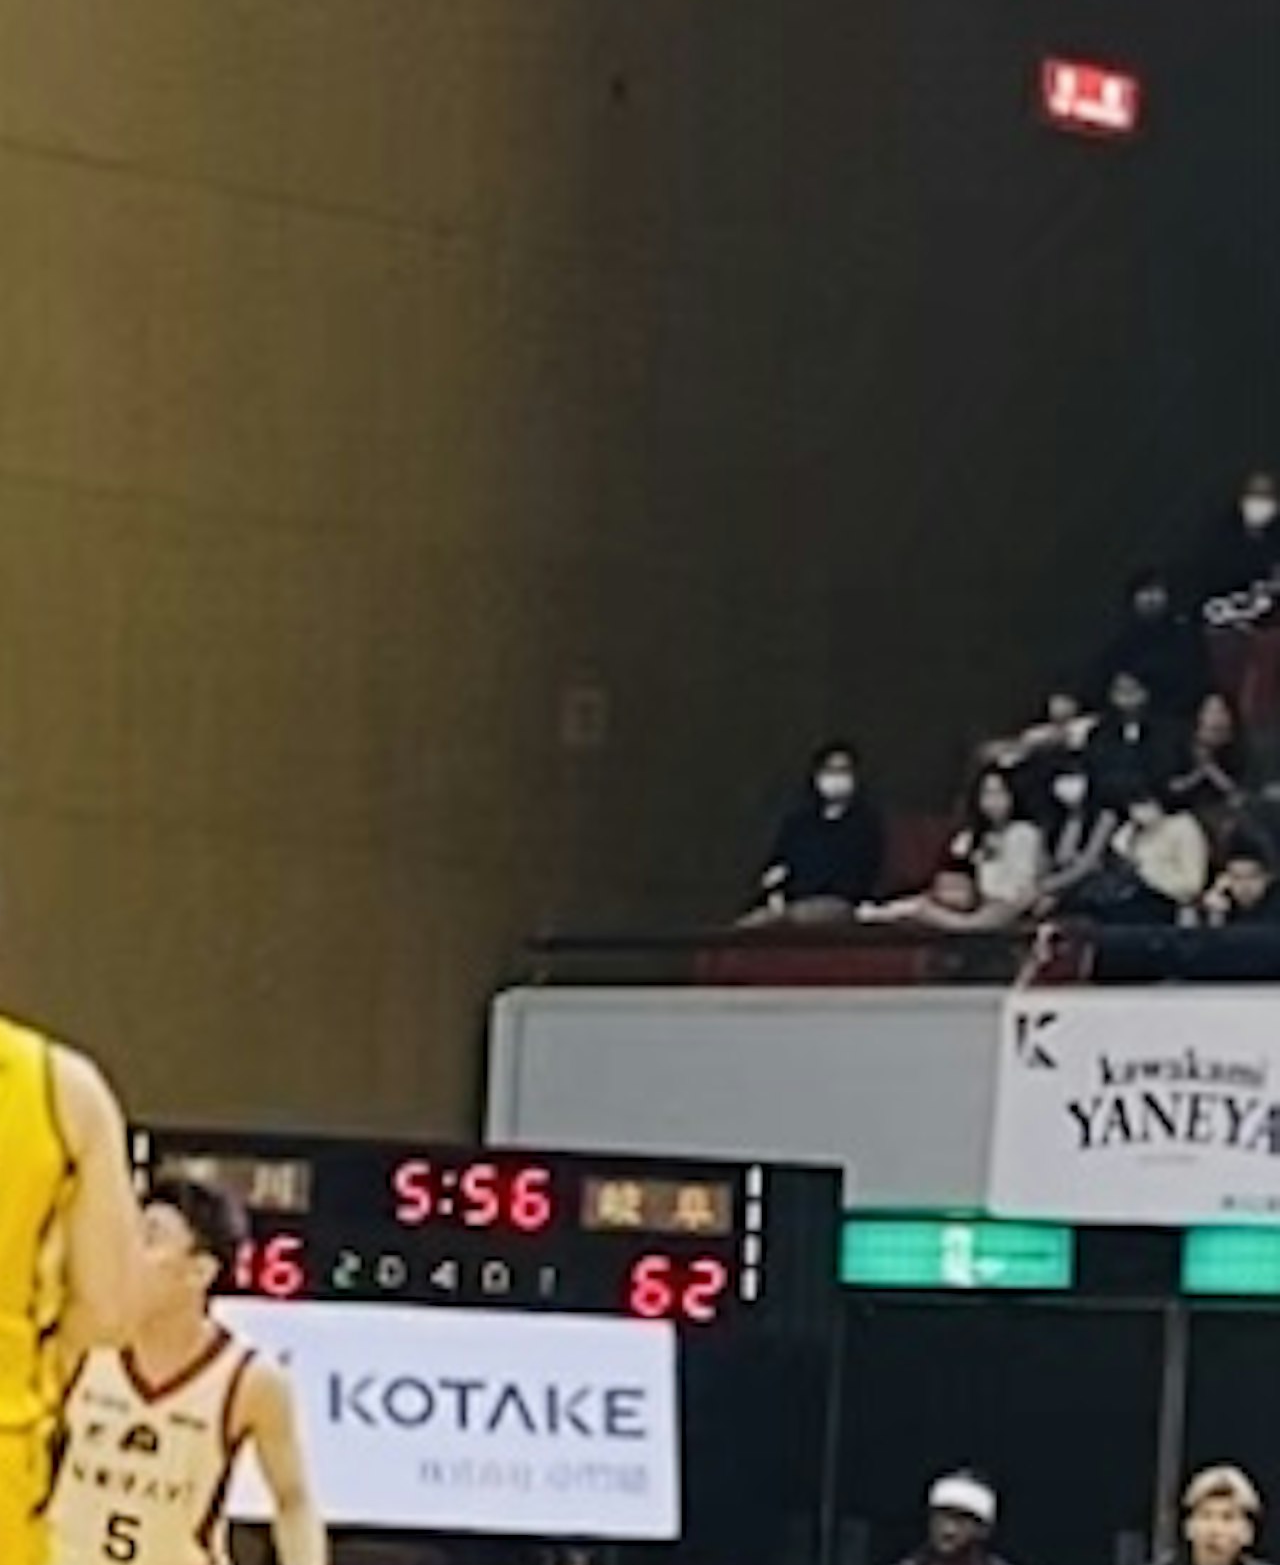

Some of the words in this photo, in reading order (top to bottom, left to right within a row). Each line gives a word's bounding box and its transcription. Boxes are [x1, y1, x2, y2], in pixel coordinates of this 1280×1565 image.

[394, 1160, 550, 1231] 5:56
[630, 1256, 728, 1320] 62
[329, 1373, 646, 1439] KOTAKE
[102, 1511, 141, 1565] 5
